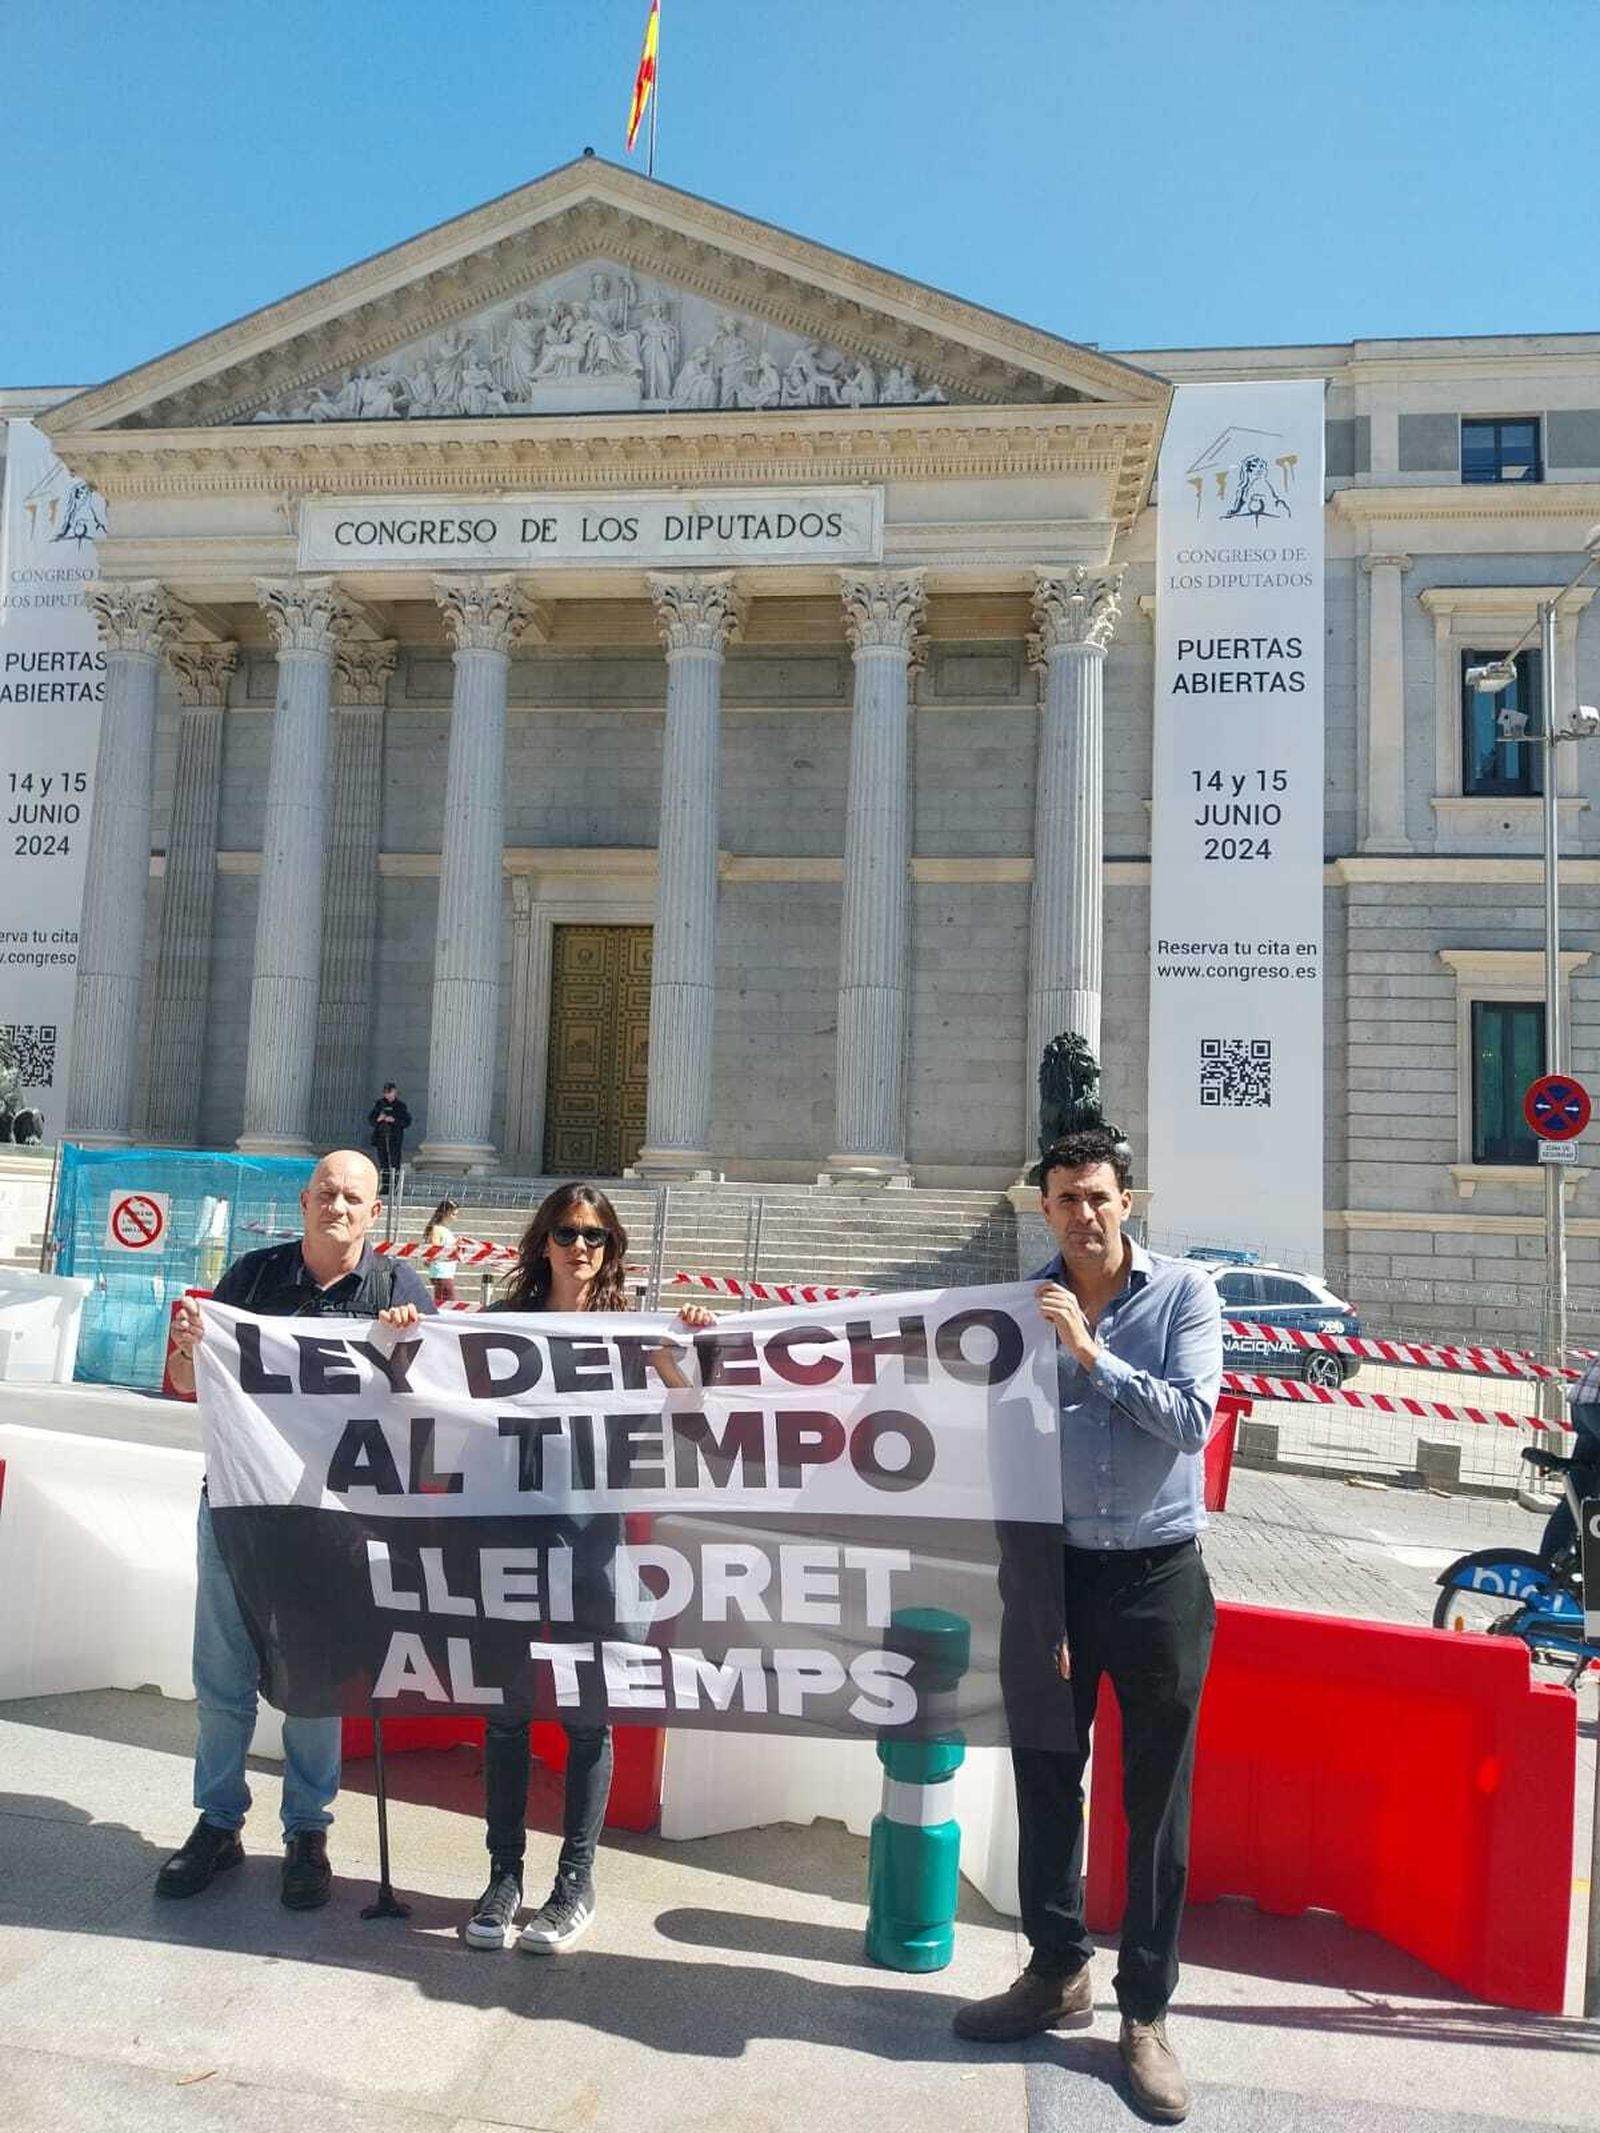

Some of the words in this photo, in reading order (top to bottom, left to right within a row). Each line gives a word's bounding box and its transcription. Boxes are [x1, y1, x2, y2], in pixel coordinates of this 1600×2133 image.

[334, 518, 498, 545] CONGRESO
[520, 518, 558, 543] DE
[581, 517, 640, 543] LOS
[664, 513, 843, 542] DIPUTADOS
[1176, 548, 1277, 564] CONGRESO
[1282, 547, 1308, 562] DE
[11, 568, 94, 582] CONGRESO
[1169, 574, 1203, 590] LOS
[1207, 573, 1313, 589] DIPUTADOS
[35, 593, 84, 608] DIPUT
[1177, 637, 1303, 661] PUERTAS
[5, 650, 108, 672] PUERTAS
[0, 682, 106, 703] ABIERTAS
[1171, 670, 1306, 694] ABIERTAS
[8, 772, 33, 793] 14
[40, 777, 53, 798] y
[60, 772, 87, 792] 15
[1191, 769, 1224, 792] 14
[1231, 775, 1246, 797] y
[1255, 769, 1288, 791] 15
[8, 803, 80, 824] JUNIO
[1194, 803, 1282, 826] JUNIO
[14, 835, 70, 856] 2024
[1204, 838, 1272, 860] 2024
[0, 931, 28, 943] erva
[32, 929, 47, 943] tu
[51, 928, 78, 943] cita
[1157, 939, 1229, 956] Reserva
[1234, 941, 1252, 956] tu
[1257, 940, 1291, 956] cita
[1296, 943, 1318, 956] en
[1157, 965, 1317, 982] www.congreso.es
[235, 1321, 424, 1395] LEY
[458, 1308, 1025, 1399] DERECHO
[1222, 1339, 1301, 1353] NACIONAL
[326, 1417, 464, 1495] AL
[498, 1409, 936, 1493] TIEMPO
[366, 1539, 574, 1622] LLEI
[615, 1543, 911, 1628] DRET
[371, 1631, 504, 1704] AL
[529, 1640, 918, 1726] TEMPS
